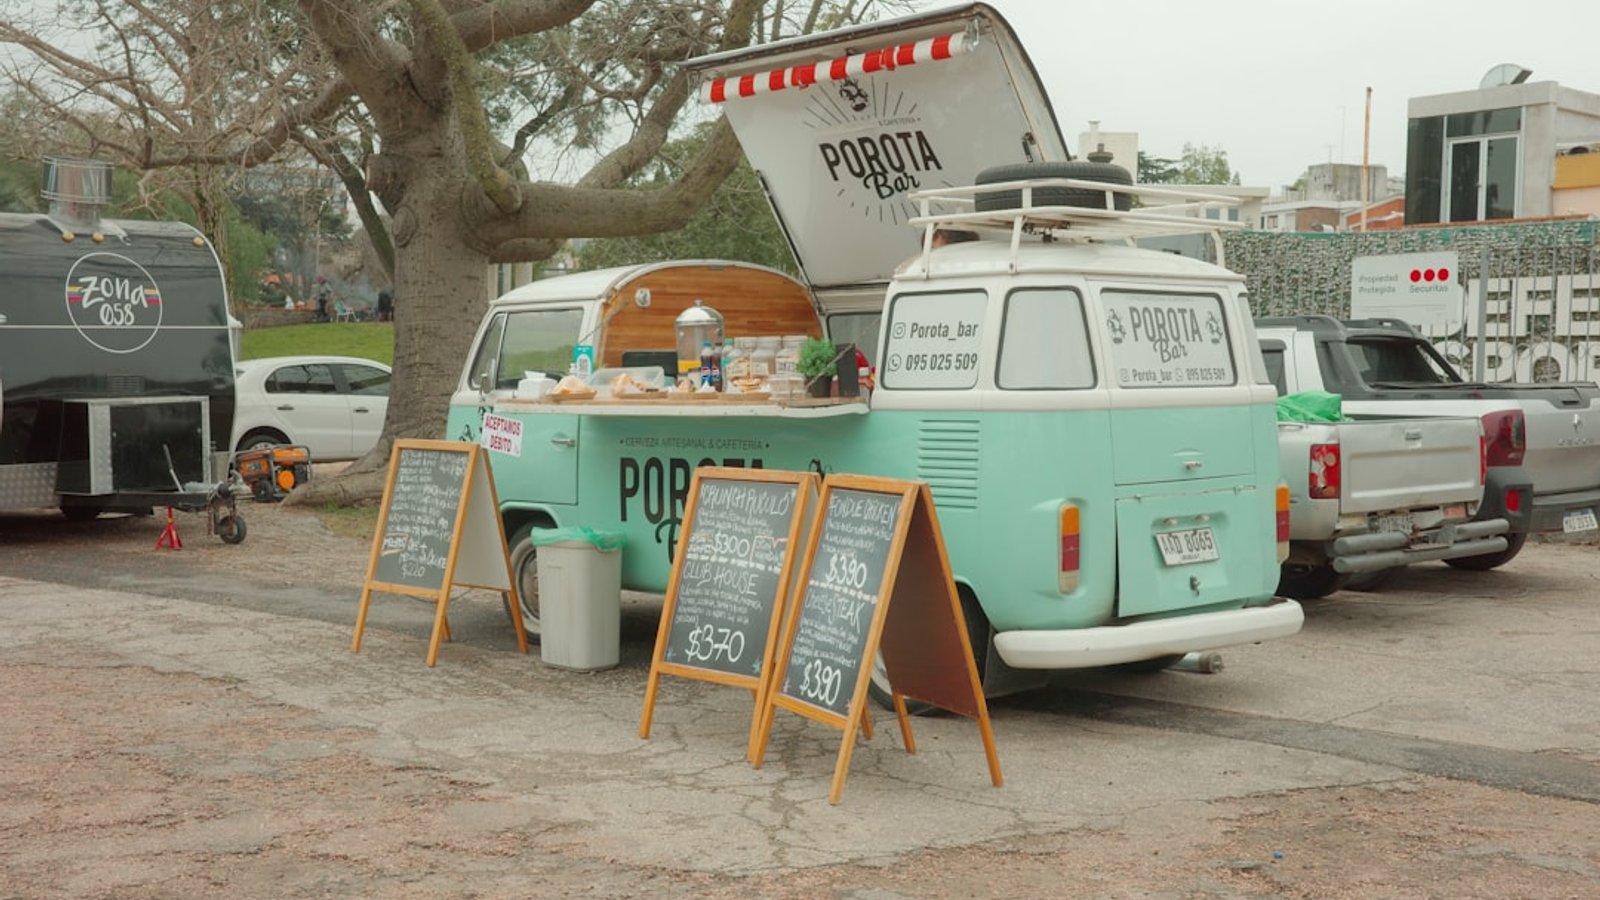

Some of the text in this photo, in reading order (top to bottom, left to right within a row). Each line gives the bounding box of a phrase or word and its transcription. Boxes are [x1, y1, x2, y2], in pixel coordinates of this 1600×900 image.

[819, 130, 942, 181] POROTA
[863, 171, 920, 199] Bar
[1358, 273, 1398, 283] Propiedad
[1409, 285, 1448, 293] Securitas
[79, 276, 148, 308] Zona
[1358, 286, 1396, 296] Protegida
[100, 302, 135, 325] 058
[1129, 306, 1203, 342] POROTA
[910, 321, 978, 341] Porota_bar
[905, 352, 978, 371] 095 025 509
[1153, 339, 1188, 363] Bar
[625, 436, 659, 448] CERVEZA
[661, 438, 706, 449] ARTESANAL
[714, 531, 751, 558] $300
[1184, 531, 1213, 552] 8065
[713, 565, 760, 596] HOUSE
[825, 553, 867, 589] $390
[685, 623, 745, 662] $370
[800, 659, 841, 706] $390
